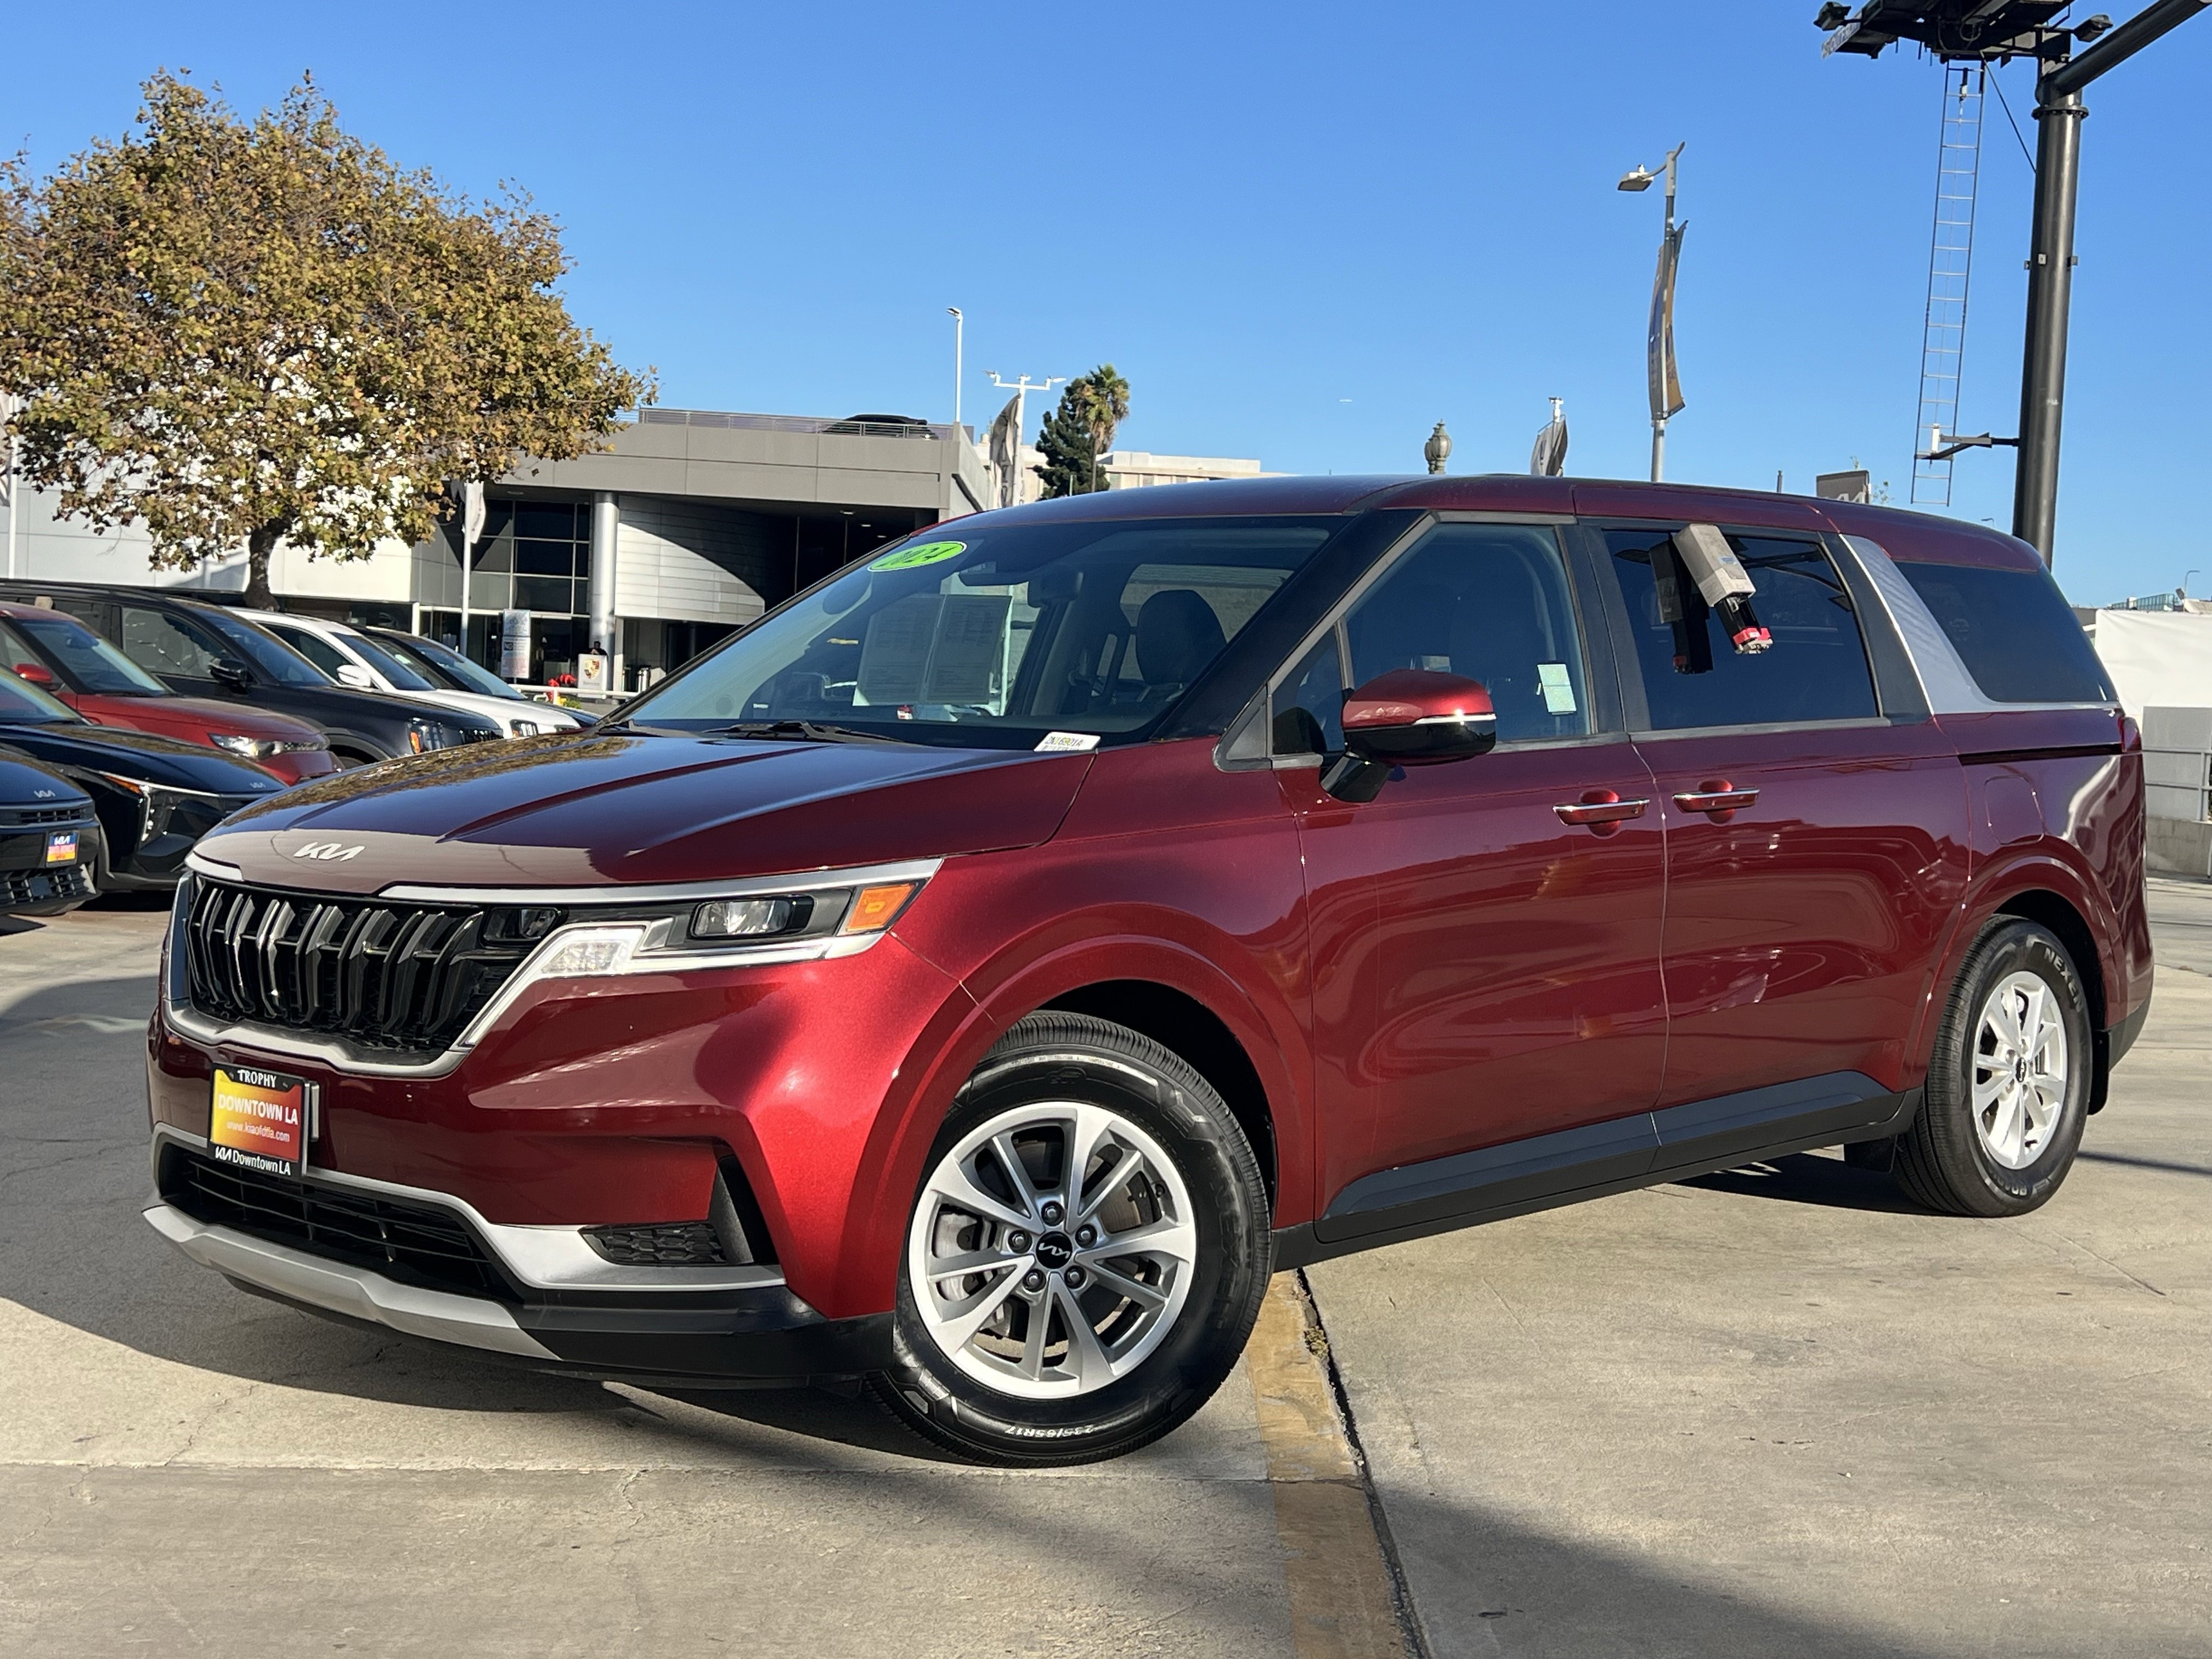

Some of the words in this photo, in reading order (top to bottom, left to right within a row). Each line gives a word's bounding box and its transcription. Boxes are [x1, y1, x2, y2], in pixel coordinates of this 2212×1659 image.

[293, 842, 365, 861] KIA
[2044, 947, 2084, 1013] NEXEN
[237, 1069, 277, 1088] TROPHY
[218, 1093, 283, 1122] DOWNTOWN
[284, 1107, 299, 1126] LA
[232, 1149, 278, 1173] Downtown
[279, 1160, 291, 1176] LA
[1005, 1424, 1094, 1438] 235/65R17
